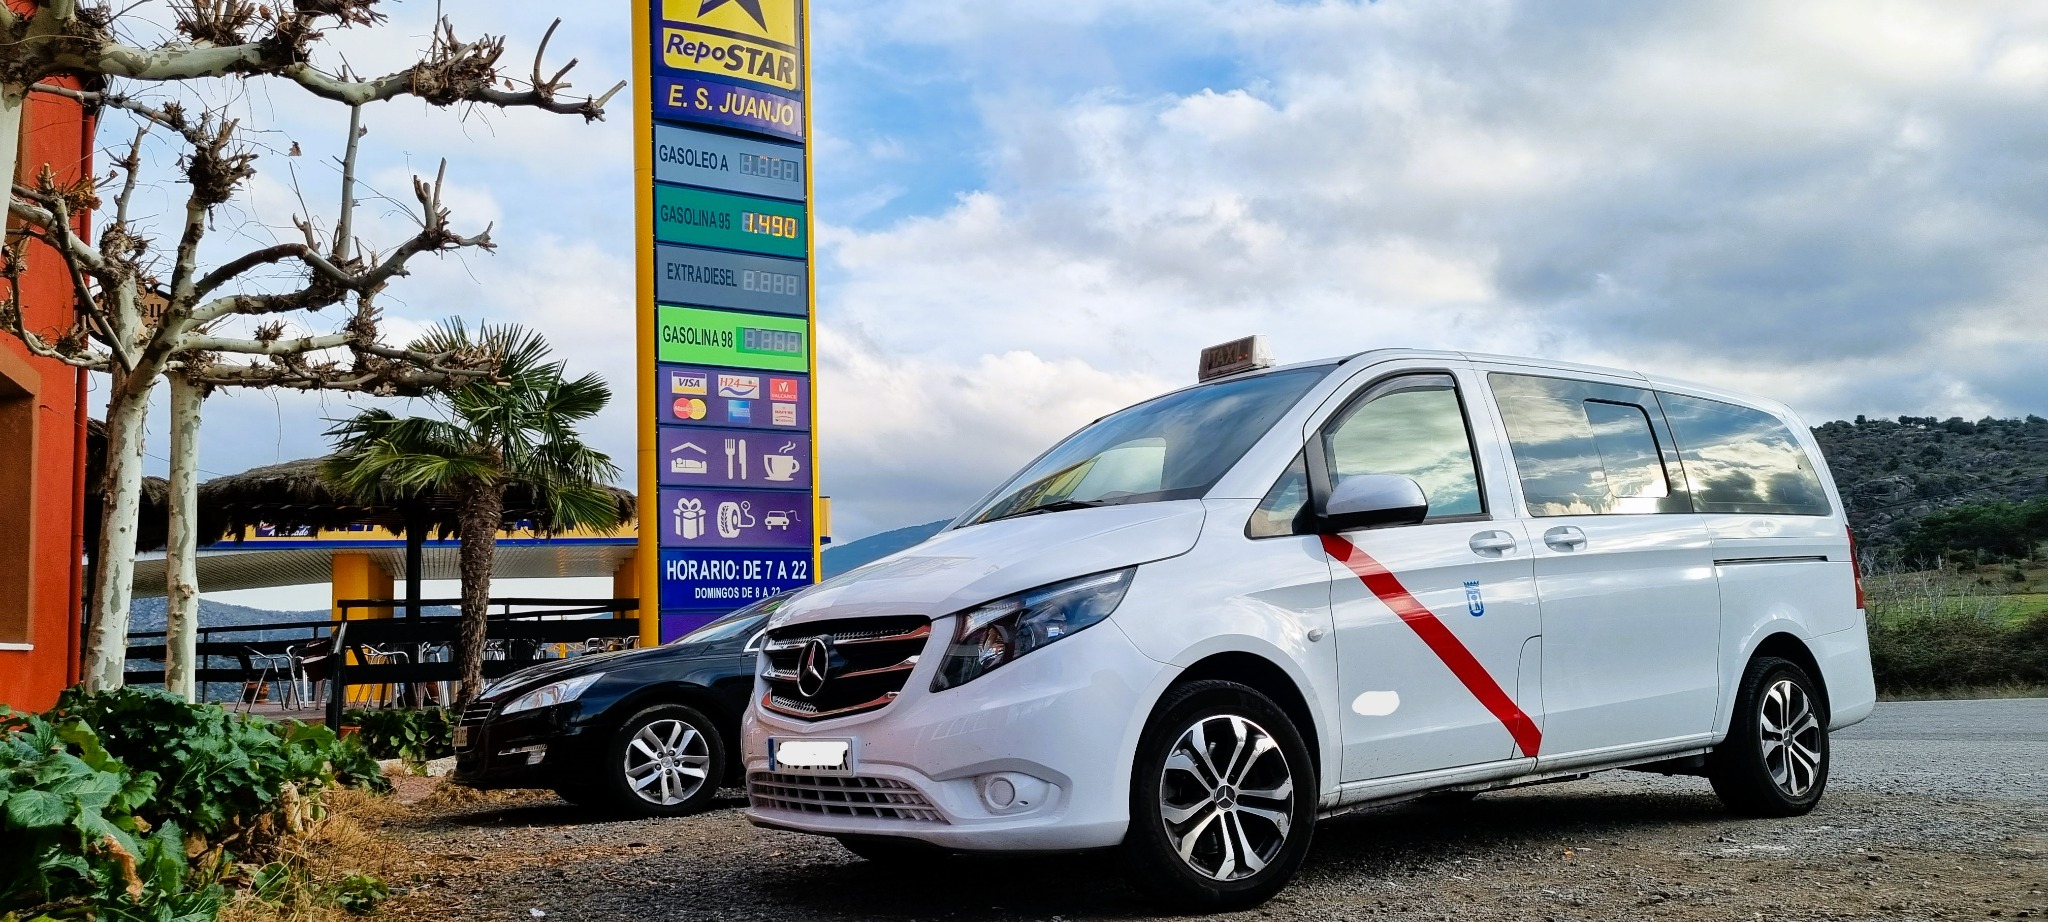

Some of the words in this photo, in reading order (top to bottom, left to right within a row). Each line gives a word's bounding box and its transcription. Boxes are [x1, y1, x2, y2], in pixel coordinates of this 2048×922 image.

[666, 33, 795, 85] RepoSTAR
[668, 84, 688, 107] E.
[694, 87, 713, 111] S.
[719, 92, 794, 126] JUANJO
[659, 144, 718, 170] GASOLEO
[720, 155, 729, 171] A
[660, 204, 717, 228] GASOLINA
[719, 212, 731, 230] 95
[748, 213, 796, 239] 1.490
[662, 324, 719, 347] GASOLINA
[721, 330, 734, 348] 98
[1211, 342, 1241, 367] TAXI
[678, 378, 701, 388] VISA
[720, 377, 740, 388] H24
[666, 559, 740, 581] HORARIO:
[743, 560, 762, 580] DE
[765, 560, 773, 580] 7
[777, 560, 788, 580] A
[791, 560, 807, 580] 22
[695, 587, 740, 599] DOMINGOS
[742, 587, 753, 598] DE
[755, 587, 760, 598] 8
[763, 587, 769, 598] A
